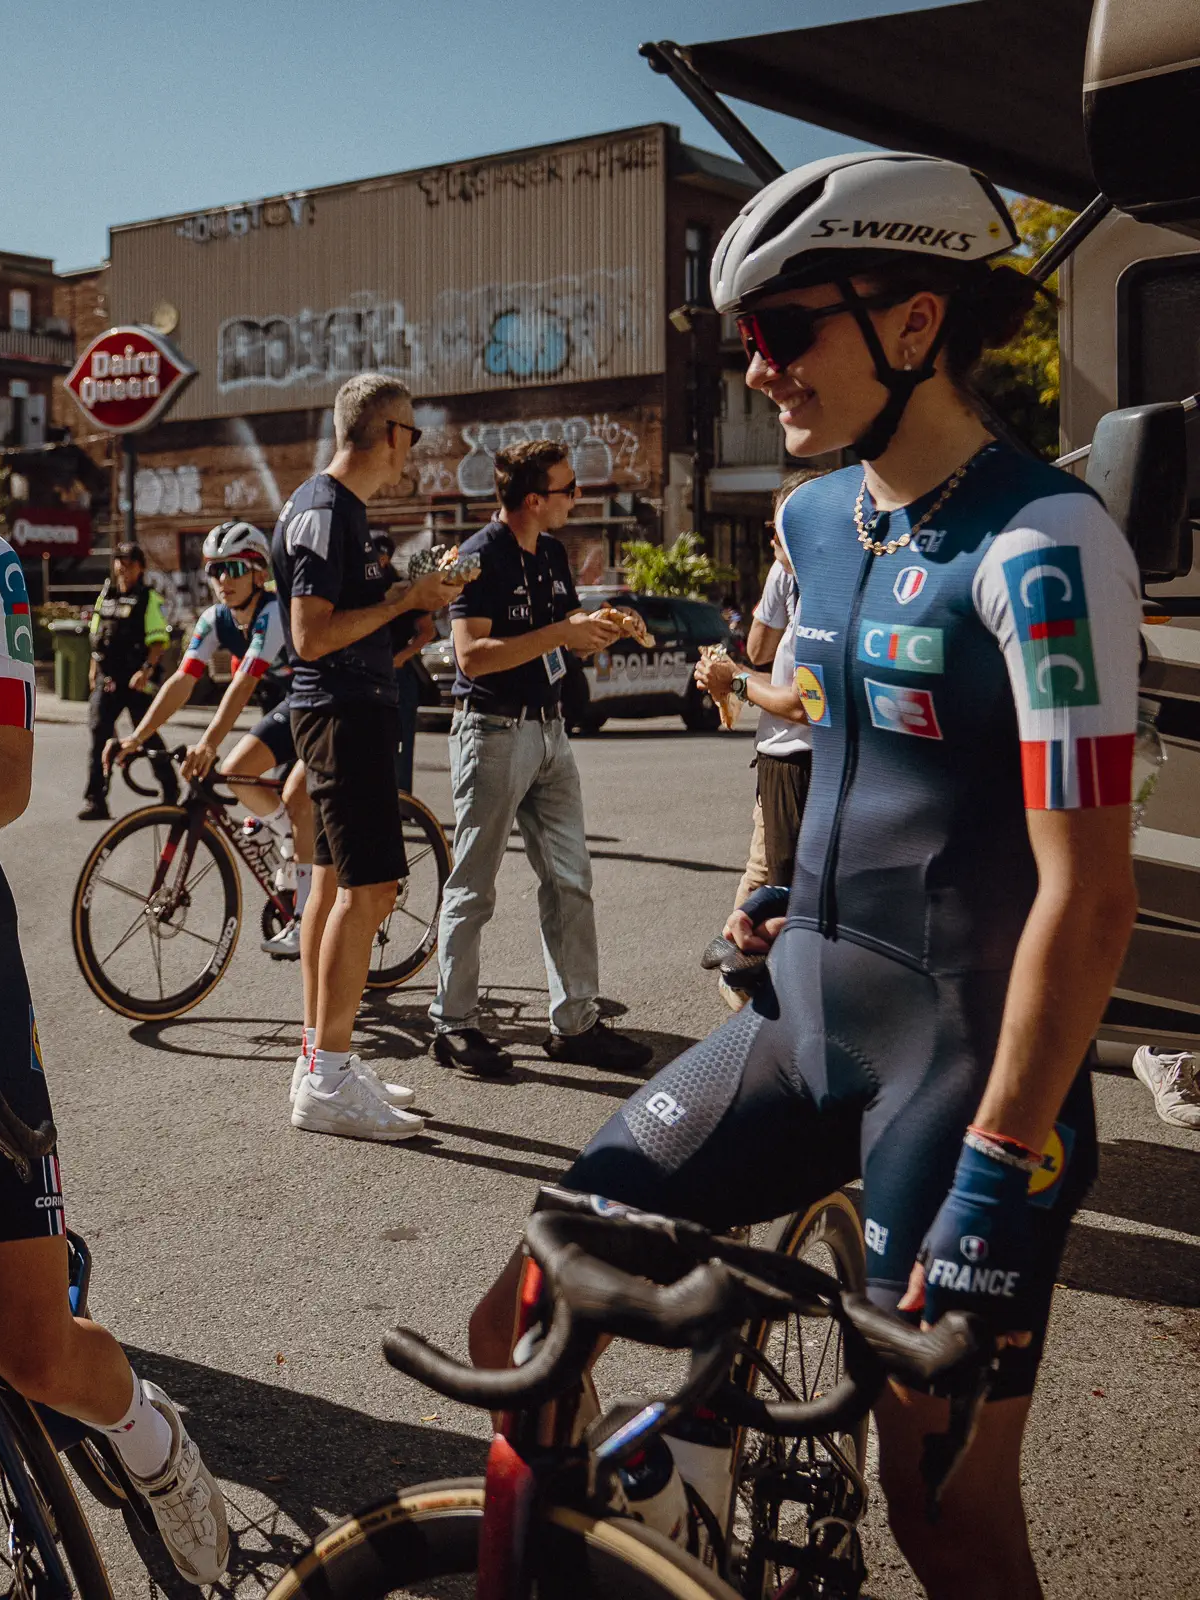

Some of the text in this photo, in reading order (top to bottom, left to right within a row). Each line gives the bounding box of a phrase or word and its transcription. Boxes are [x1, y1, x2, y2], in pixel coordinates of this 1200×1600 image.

[810, 219, 977, 252] S-WORKS
[91, 345, 160, 378] Dairy
[80, 376, 160, 409] Queen
[1020, 564, 1085, 693] CIC
[864, 629, 933, 665] CIC
[611, 651, 688, 681] POLICE
[927, 1258, 1021, 1298] FRANCE
